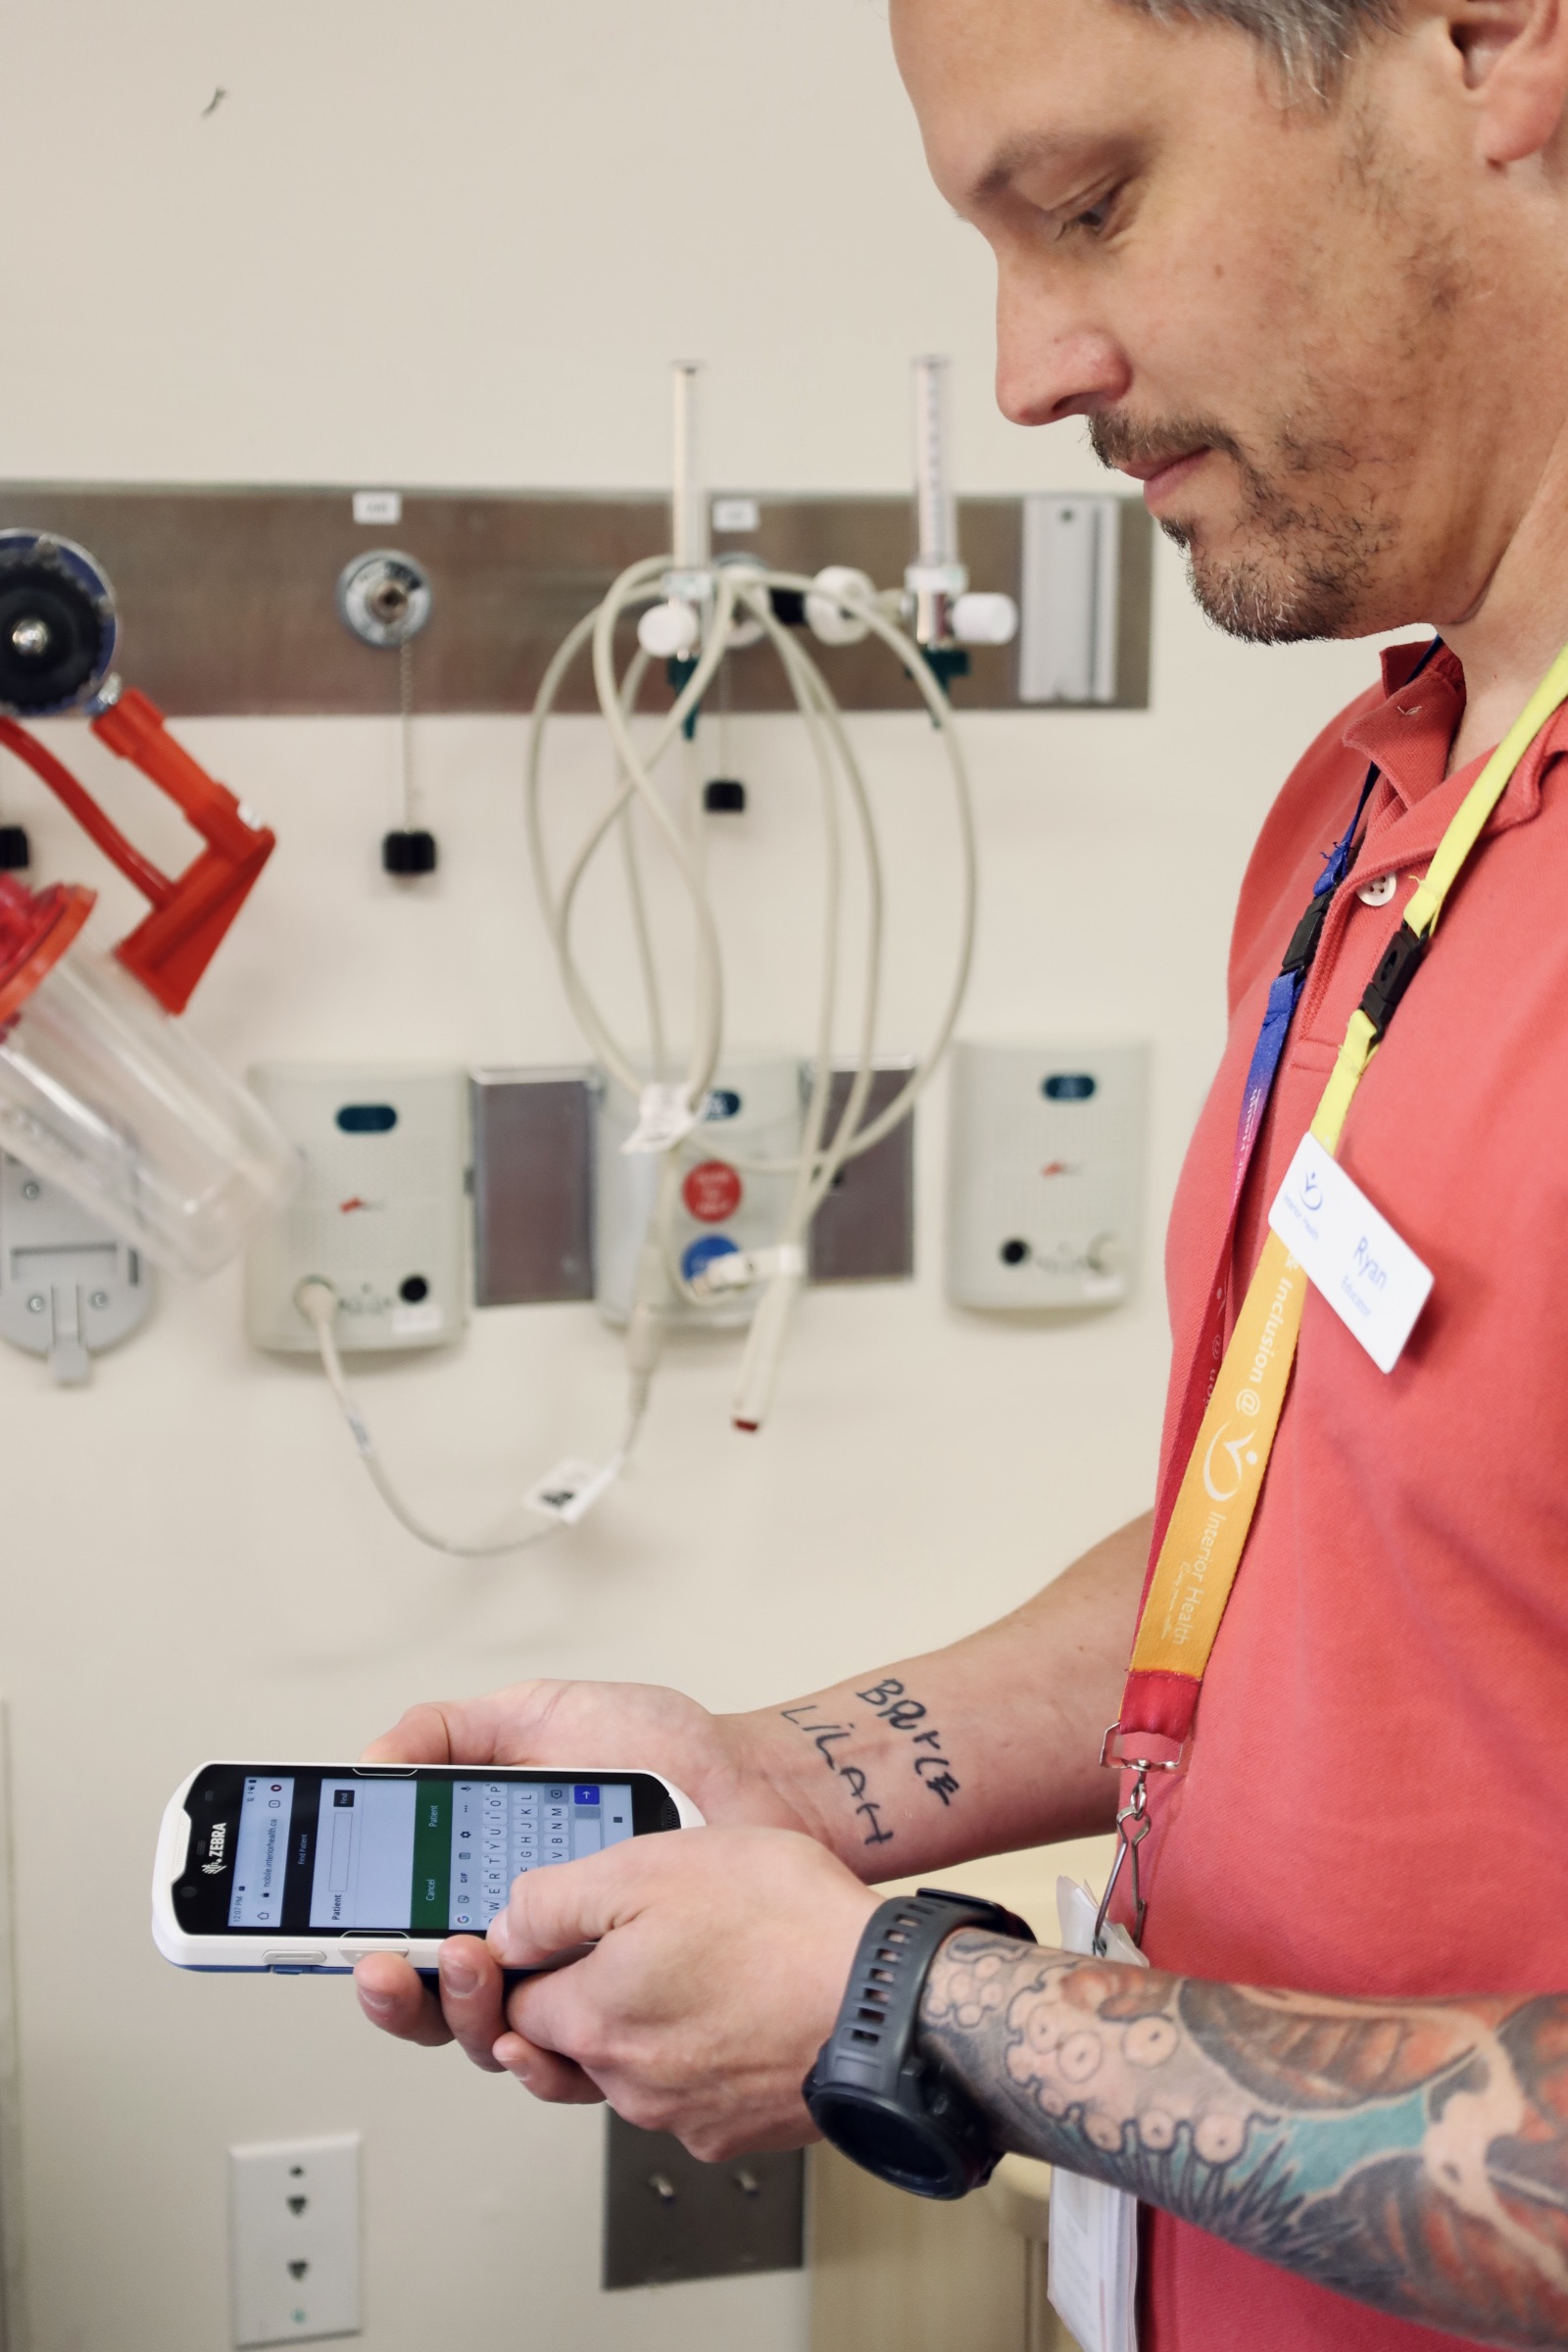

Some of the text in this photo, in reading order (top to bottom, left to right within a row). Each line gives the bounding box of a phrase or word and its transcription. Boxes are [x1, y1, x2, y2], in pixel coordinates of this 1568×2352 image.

[1352, 1235, 1388, 1291] Ryan
[1250, 1277, 1294, 1384] Inclusion
[1192, 1511, 1228, 1583] Interior
[1171, 1586, 1204, 1645] Health
[428, 1805, 439, 1828] Patient
[208, 1822, 227, 1857] ZEBRA
[298, 1834, 308, 1865] Find Patient
[425, 1879, 435, 1901] Cancel
[232, 1895, 244, 1923] 12:07 PM
[331, 1894, 342, 1921] Patient
[488, 1901, 500, 1911] W
